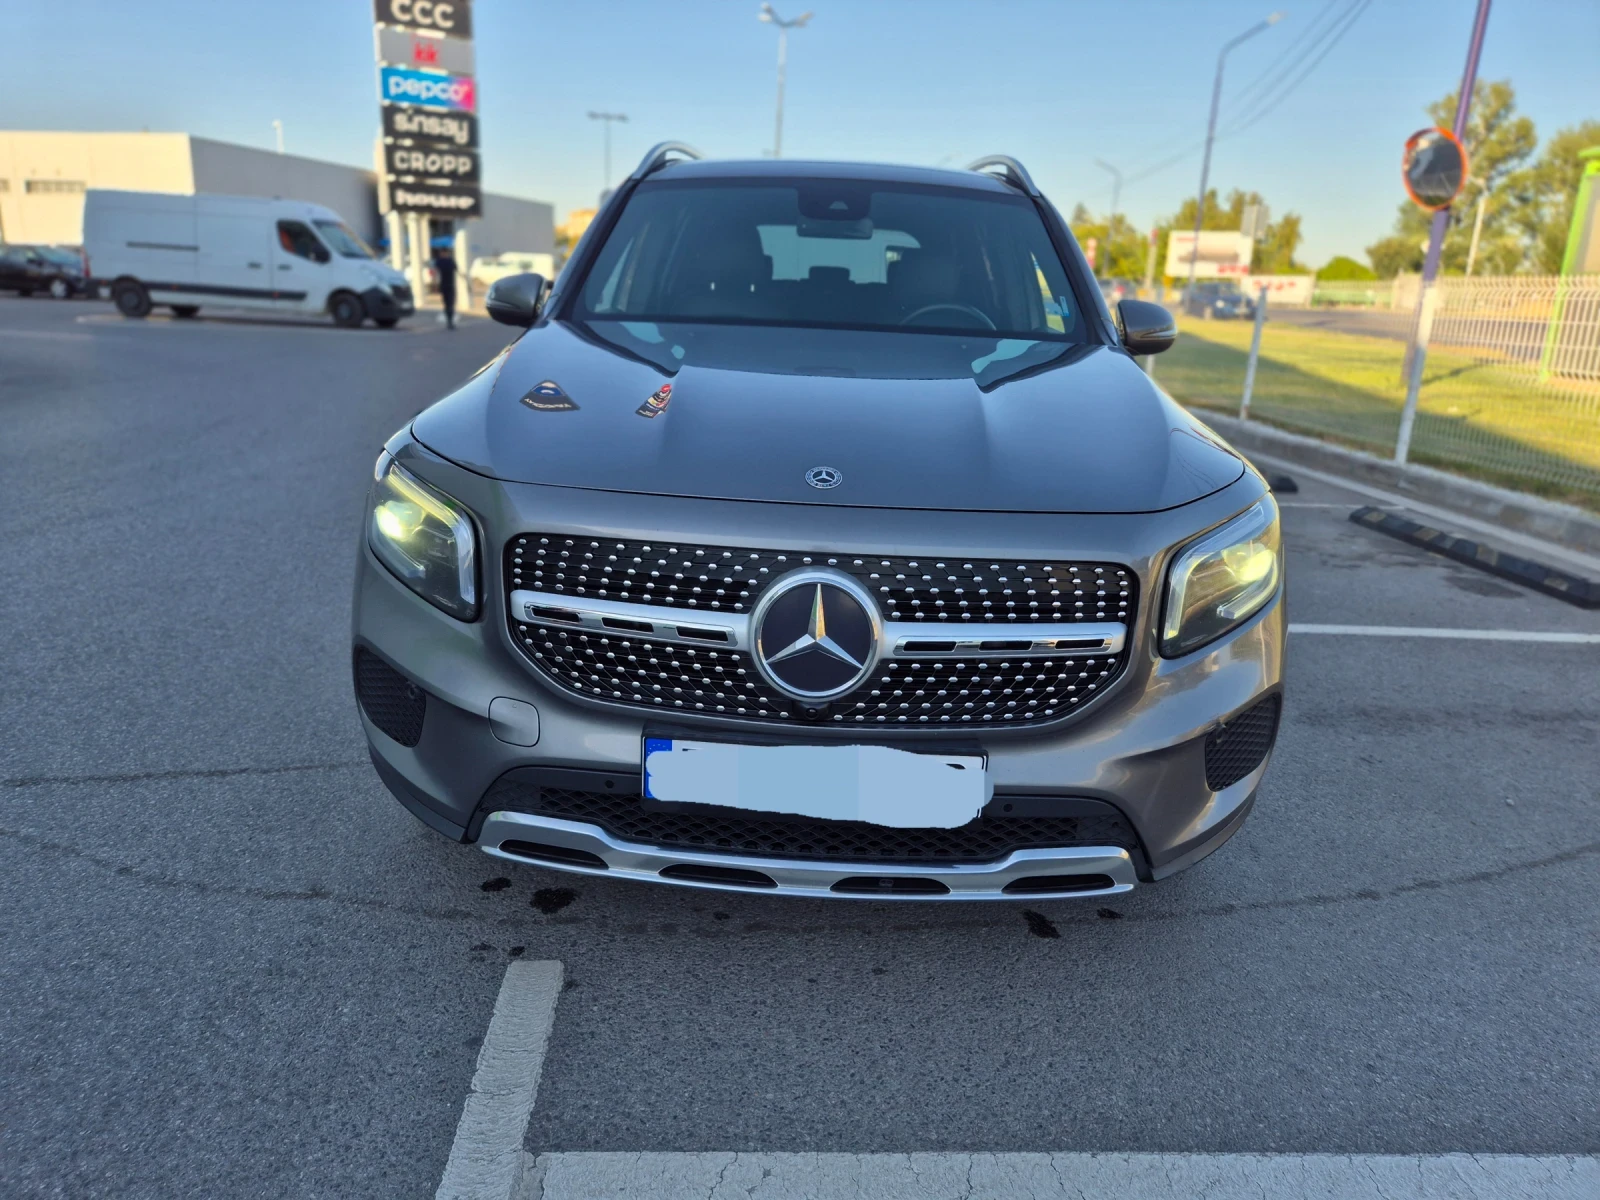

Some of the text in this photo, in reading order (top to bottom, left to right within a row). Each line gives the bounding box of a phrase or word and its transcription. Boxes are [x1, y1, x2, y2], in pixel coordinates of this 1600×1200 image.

[390, 0, 454, 28] CCC
[388, 76, 468, 101] pepco
[393, 108, 470, 145] sinsay
[394, 151, 472, 174] CROPP
